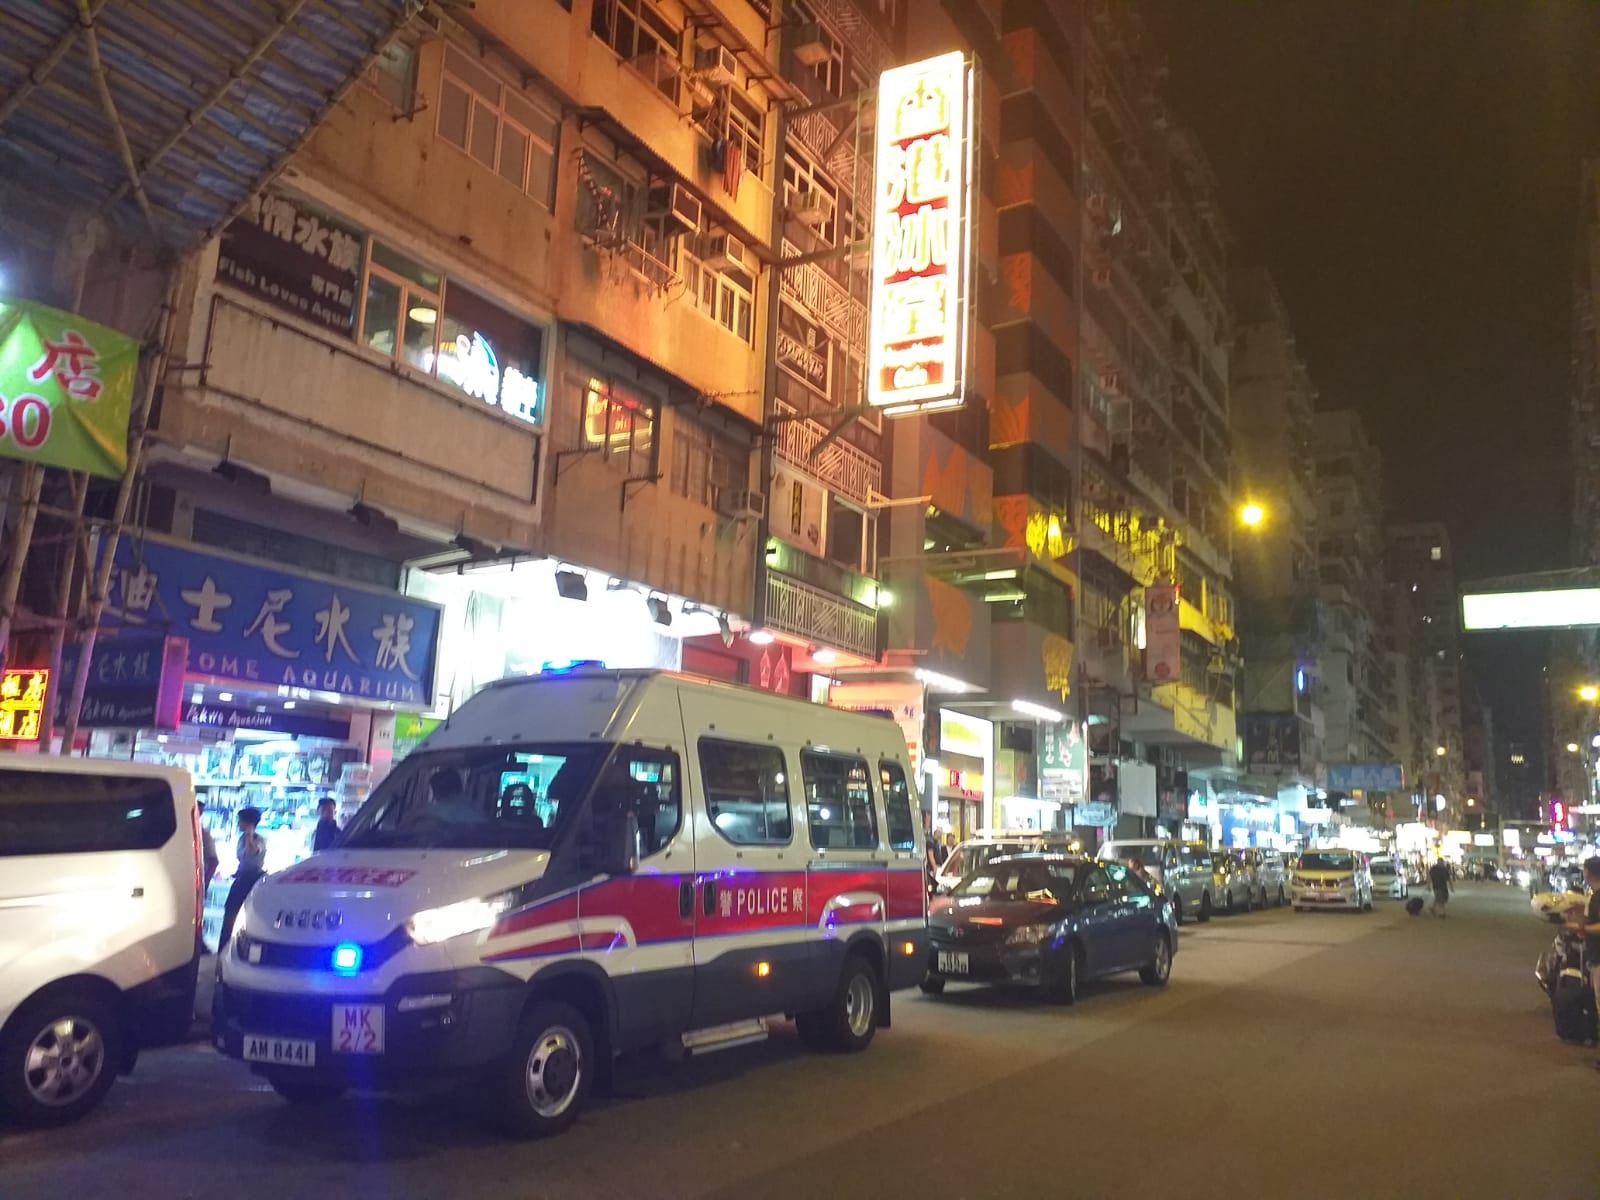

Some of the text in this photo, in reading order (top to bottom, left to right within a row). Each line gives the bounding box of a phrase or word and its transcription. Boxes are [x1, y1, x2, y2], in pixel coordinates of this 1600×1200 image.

[32, 331, 102, 398] 店
[185, 649, 415, 701] OME AQUARIUM
[720, 889, 732, 917] 警
[737, 887, 788, 916] POLICE
[793, 887, 803, 912] 察
[344, 1008, 371, 1028] MK
[250, 1040, 268, 1057] AM
[340, 1029, 376, 1051] 2/2
